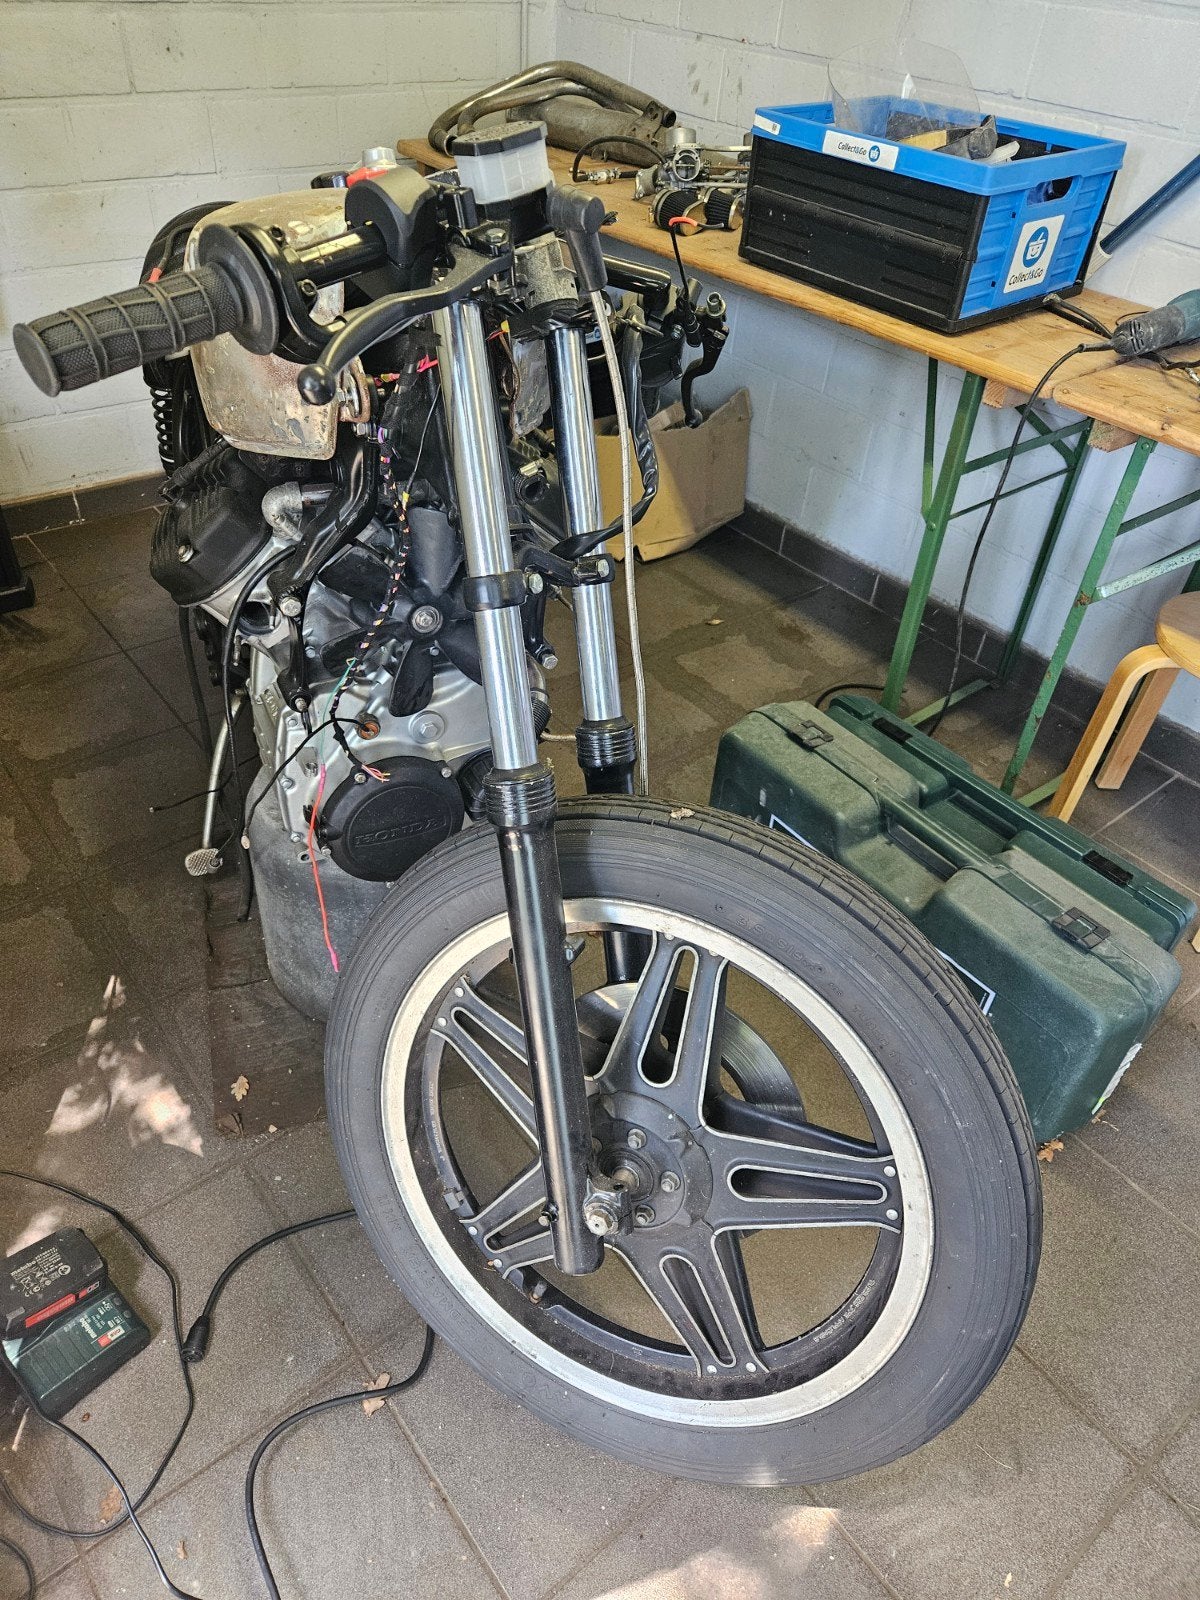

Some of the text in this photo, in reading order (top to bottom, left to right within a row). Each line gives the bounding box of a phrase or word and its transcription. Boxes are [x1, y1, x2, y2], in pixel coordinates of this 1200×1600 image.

[837, 141, 867, 155] Collect&Go
[1009, 268, 1043, 285] Collect&Go
[355, 817, 447, 848] HONDA
[10, 1260, 36, 1276] metabo
[80, 1317, 97, 1339] metabo
